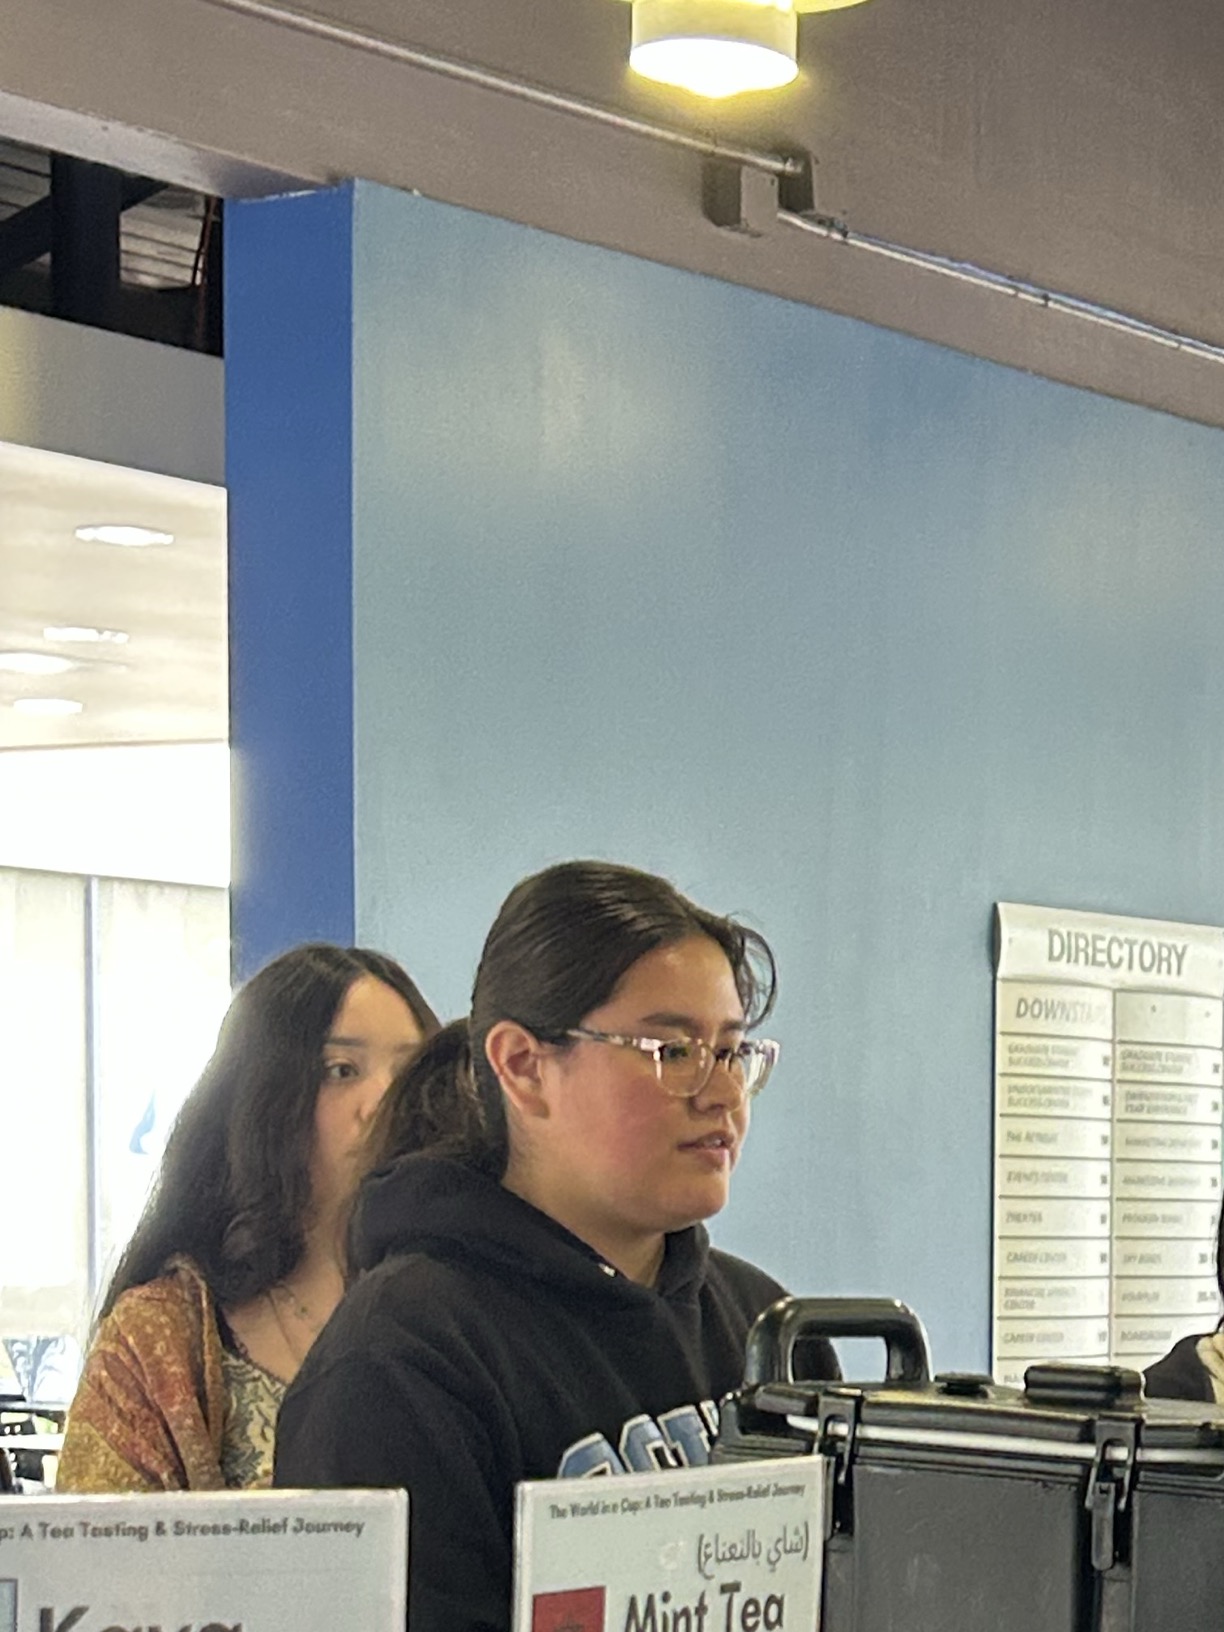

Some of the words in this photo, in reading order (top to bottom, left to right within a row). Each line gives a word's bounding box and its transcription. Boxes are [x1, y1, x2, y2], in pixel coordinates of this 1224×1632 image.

[1048, 928, 1189, 977] DIRECTORY
[20, 1523, 34, 1540] A
[40, 1522, 74, 1540] Tea
[80, 1521, 149, 1542] Tasting
[155, 1520, 167, 1536] &
[172, 1517, 288, 1537] Stress-Relief
[292, 1517, 366, 1538] Journey
